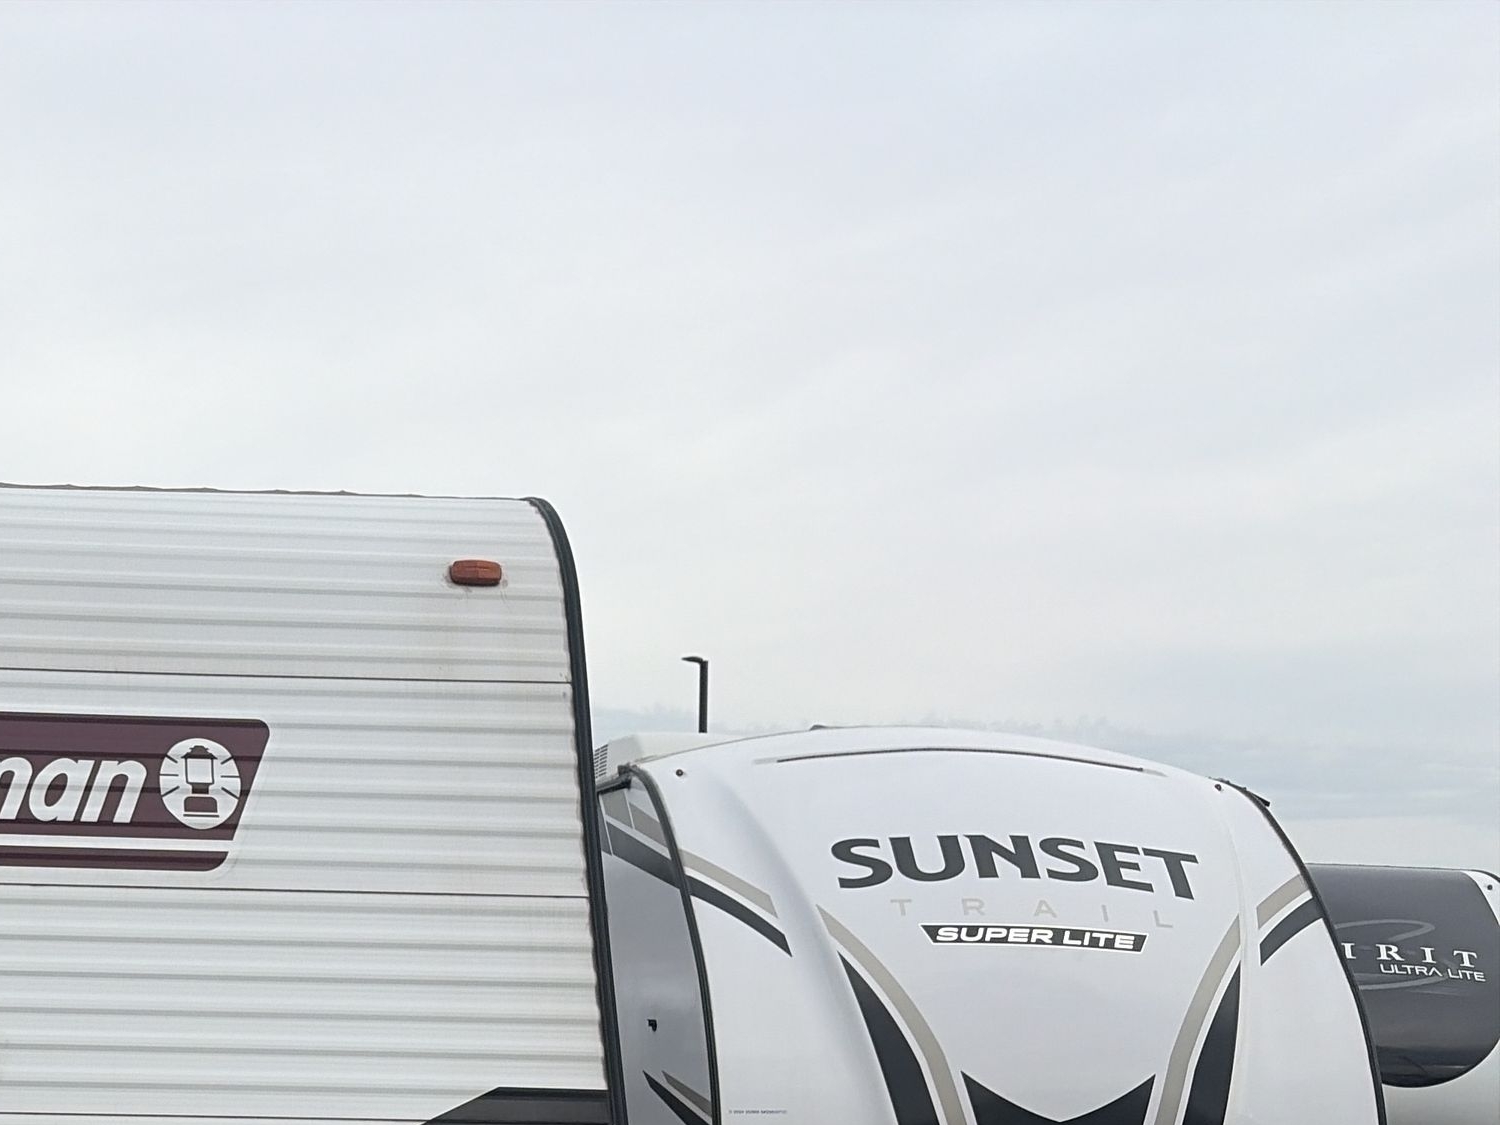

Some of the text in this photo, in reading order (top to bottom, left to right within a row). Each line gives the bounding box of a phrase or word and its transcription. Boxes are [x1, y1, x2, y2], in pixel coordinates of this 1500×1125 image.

[831, 834, 1200, 901] SUNSET
[890, 897, 1174, 929] TRAIL
[936, 926, 1135, 949] SUPER LITE
[1379, 963, 1487, 982] ULTRA LITE
